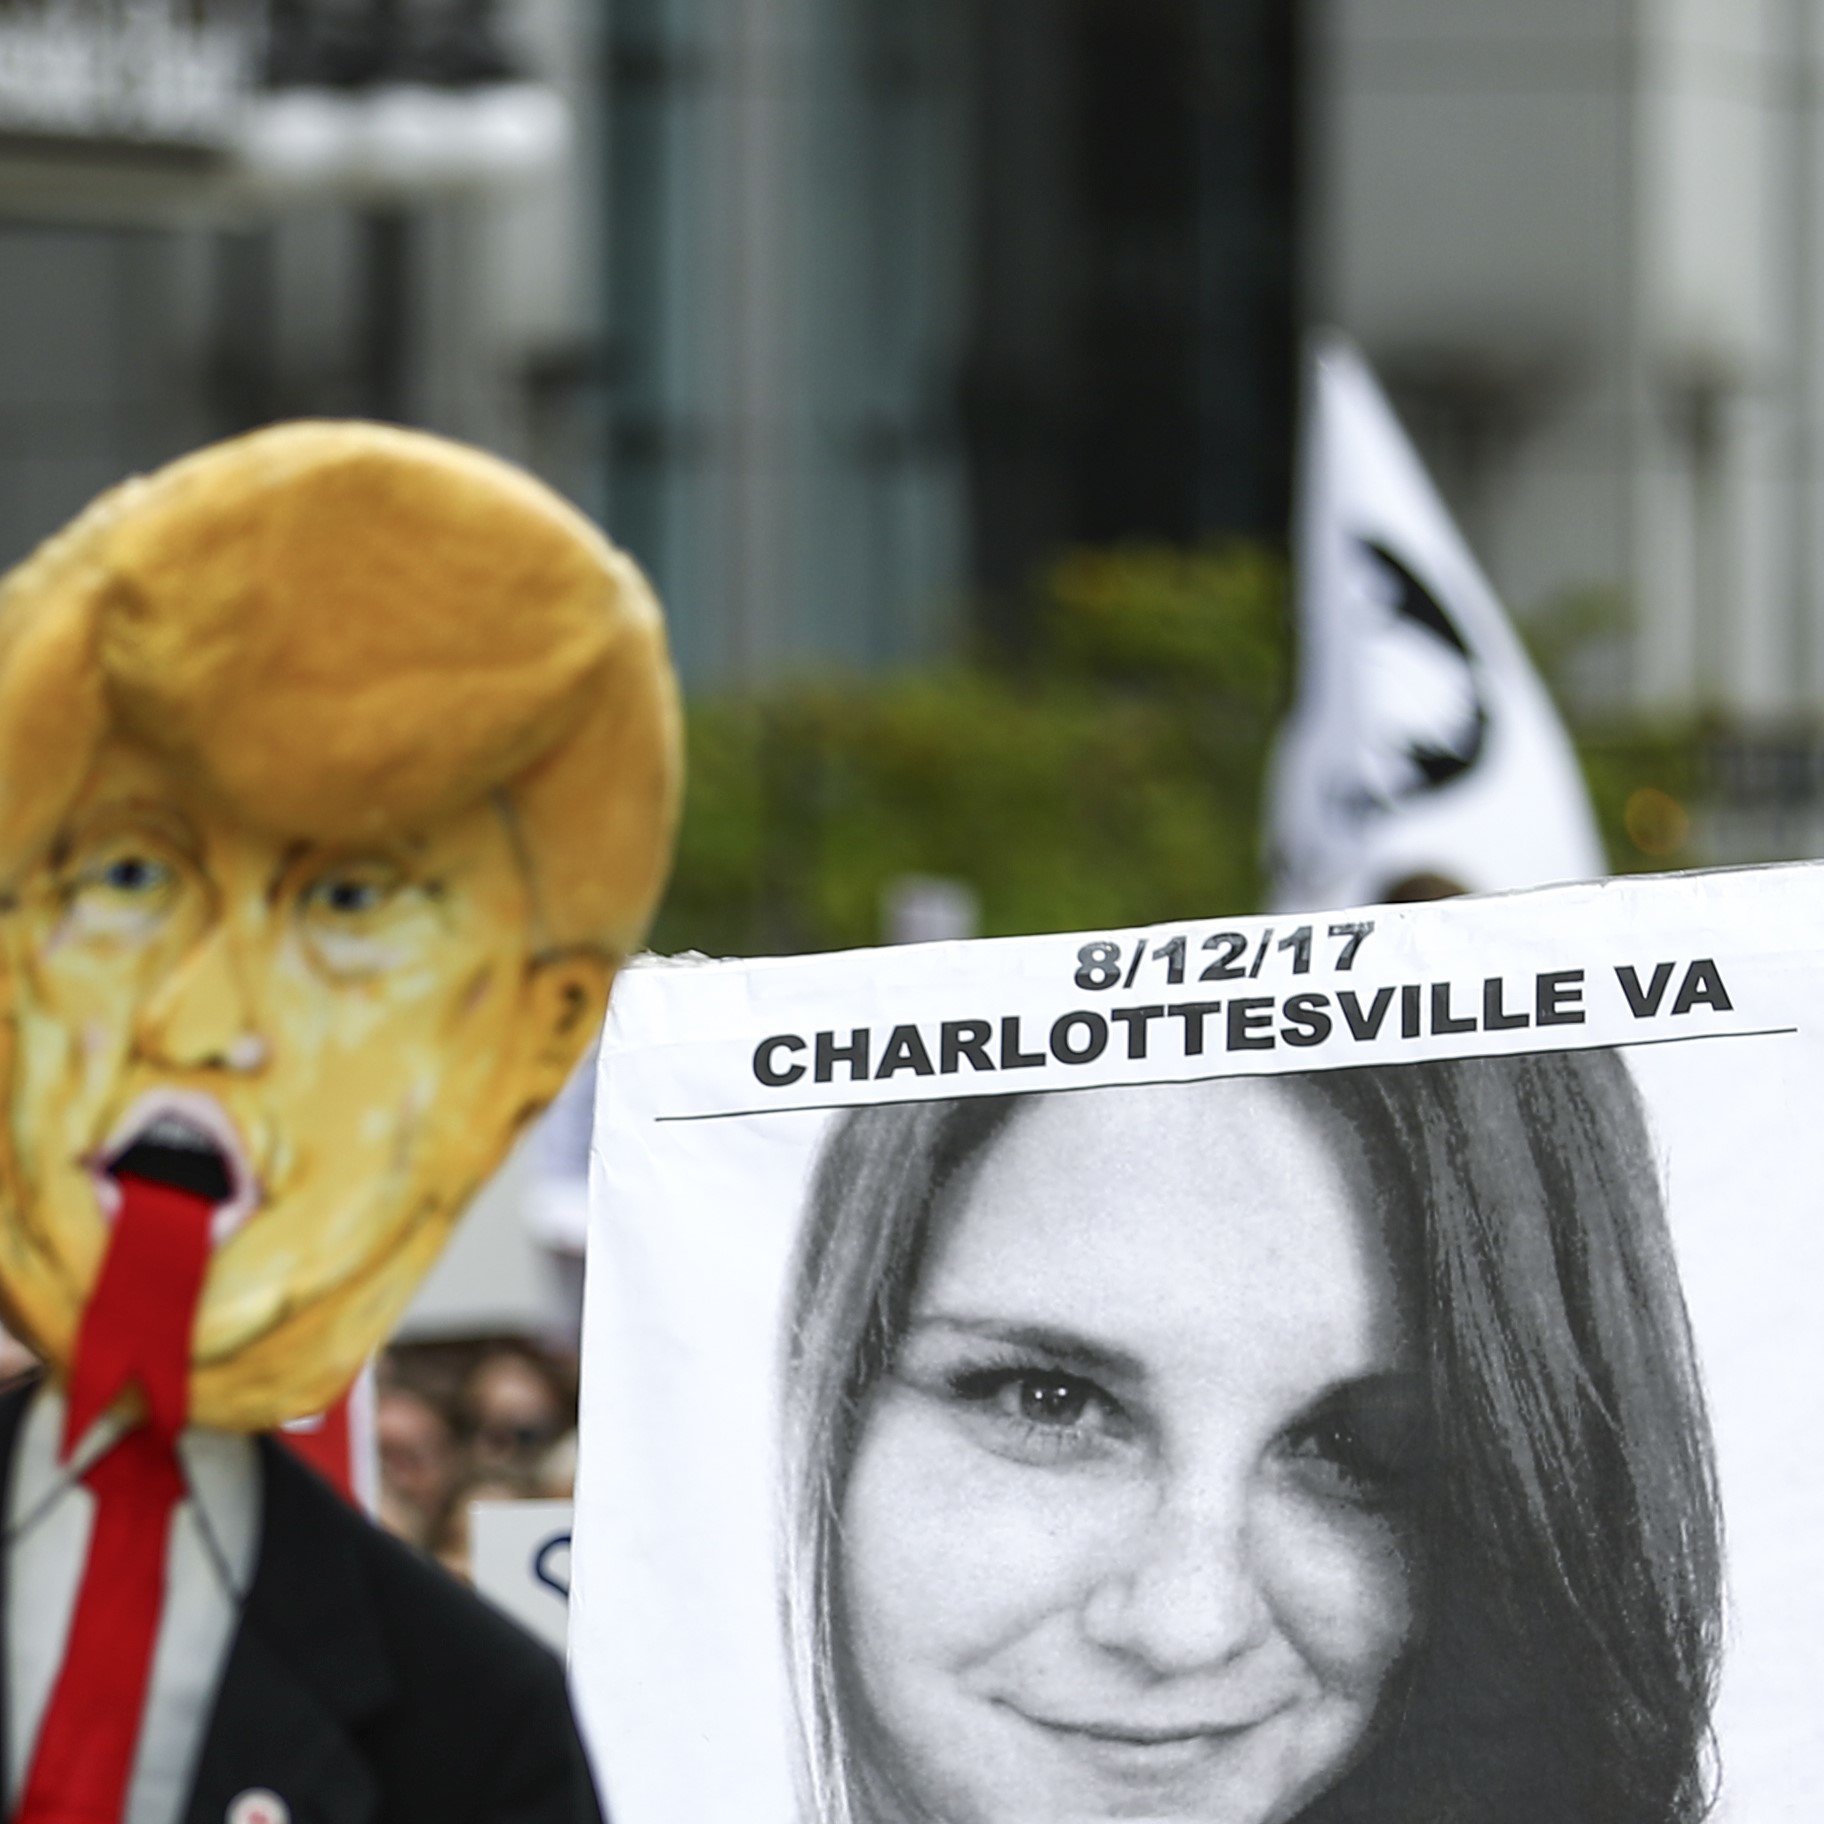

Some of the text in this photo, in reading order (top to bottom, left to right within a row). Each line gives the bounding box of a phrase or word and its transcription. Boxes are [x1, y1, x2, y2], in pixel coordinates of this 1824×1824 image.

[1074, 920, 1377, 992] 8/12/17
[751, 955, 1733, 1088] CHARLOTTESVILLE VA
